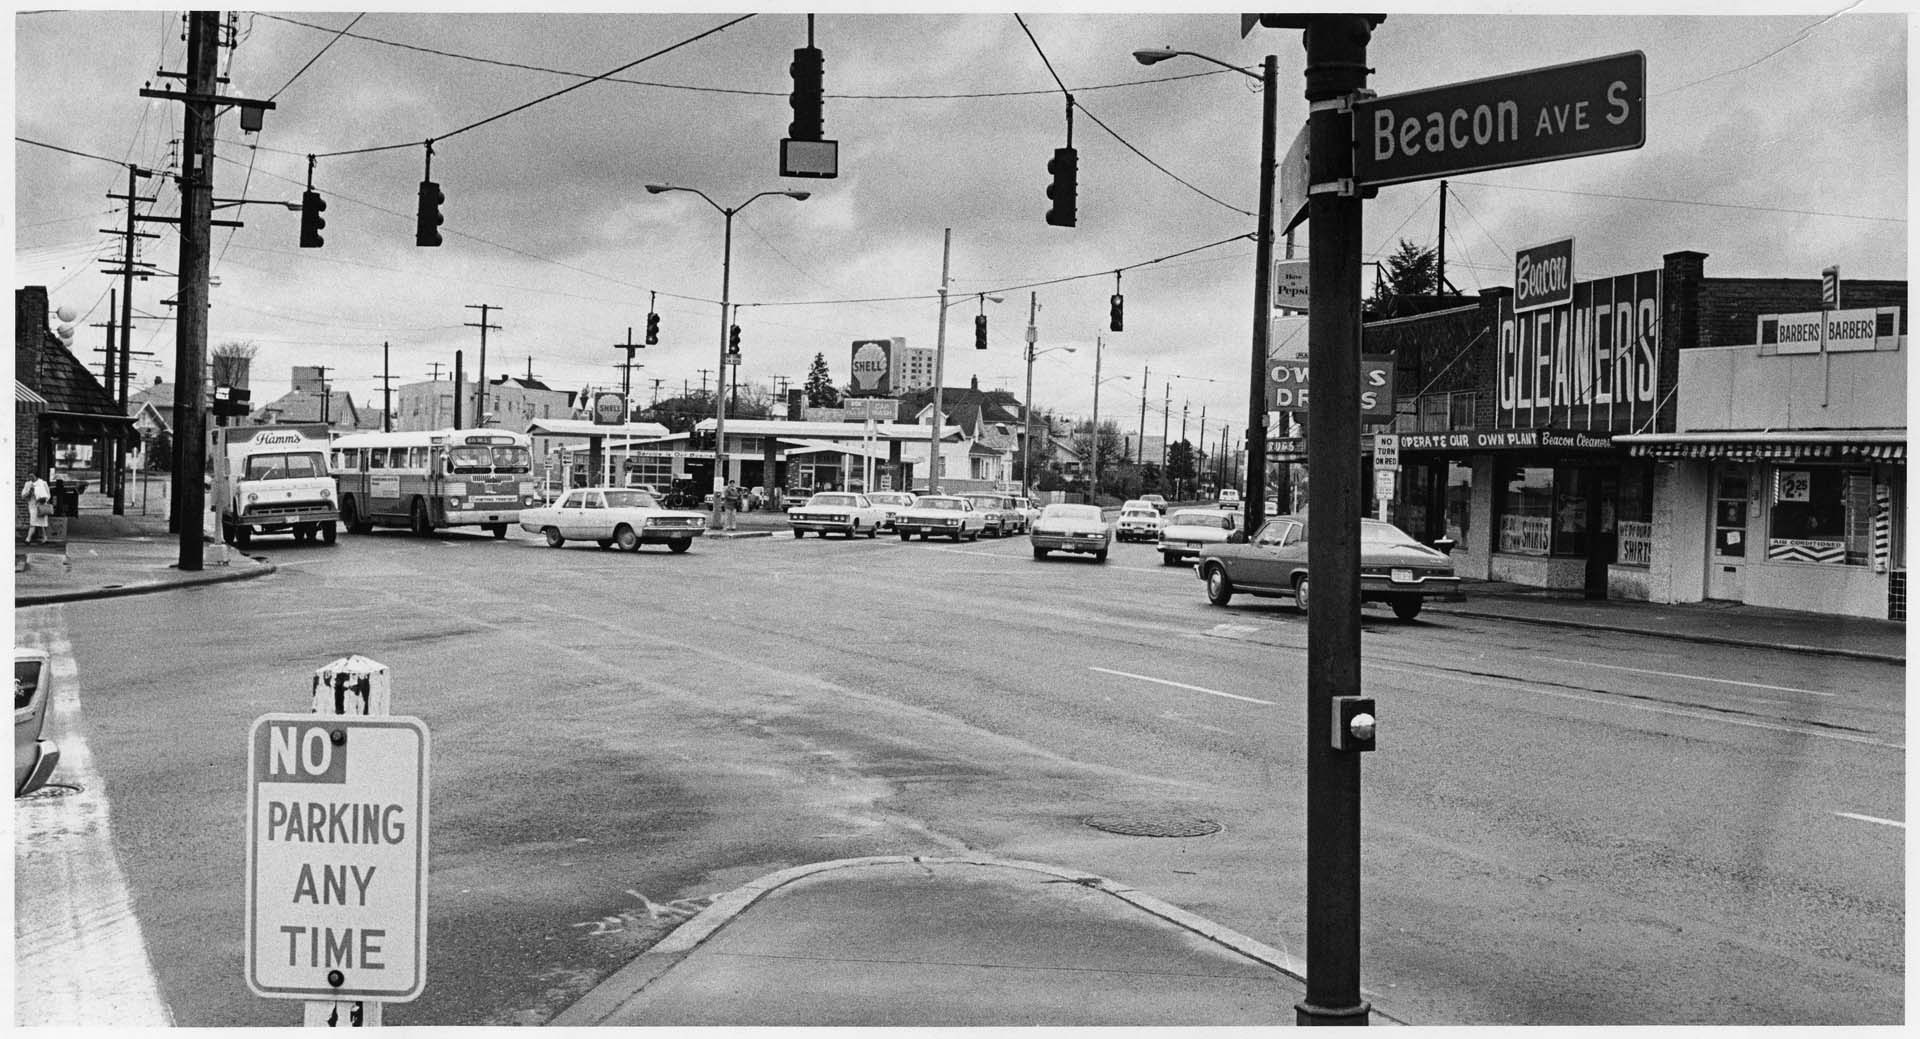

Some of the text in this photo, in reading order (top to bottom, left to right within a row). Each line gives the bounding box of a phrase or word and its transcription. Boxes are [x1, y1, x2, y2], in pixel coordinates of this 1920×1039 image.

[1374, 79, 1630, 162] Beacon AVE S
[1516, 253, 1568, 300] Beacon
[1779, 323, 1820, 343] BARBERS
[1828, 320, 1874, 340] BARBERS
[1501, 298, 1655, 411] CLEANERS
[854, 360, 883, 372] SHELL
[1271, 365, 1386, 386] OWS
[599, 404, 621, 413] SHELL
[1276, 388, 1377, 409] DRS
[256, 432, 301, 445] Hamm's
[1381, 438, 1393, 446] NO
[1401, 434, 1448, 448] OPERATE
[1450, 434, 1470, 447] OUR
[1478, 434, 1504, 447] OWN
[1507, 432, 1537, 446] PLANT
[1542, 432, 1574, 447] Beacon
[1375, 457, 1397, 465] ON RED
[1377, 447, 1396, 456] TURN
[1790, 540, 1841, 548] CONDITIONED
[269, 726, 332, 776] NO
[268, 801, 406, 845] PARKING
[292, 863, 377, 906] ANY
[280, 925, 386, 970] TIME
